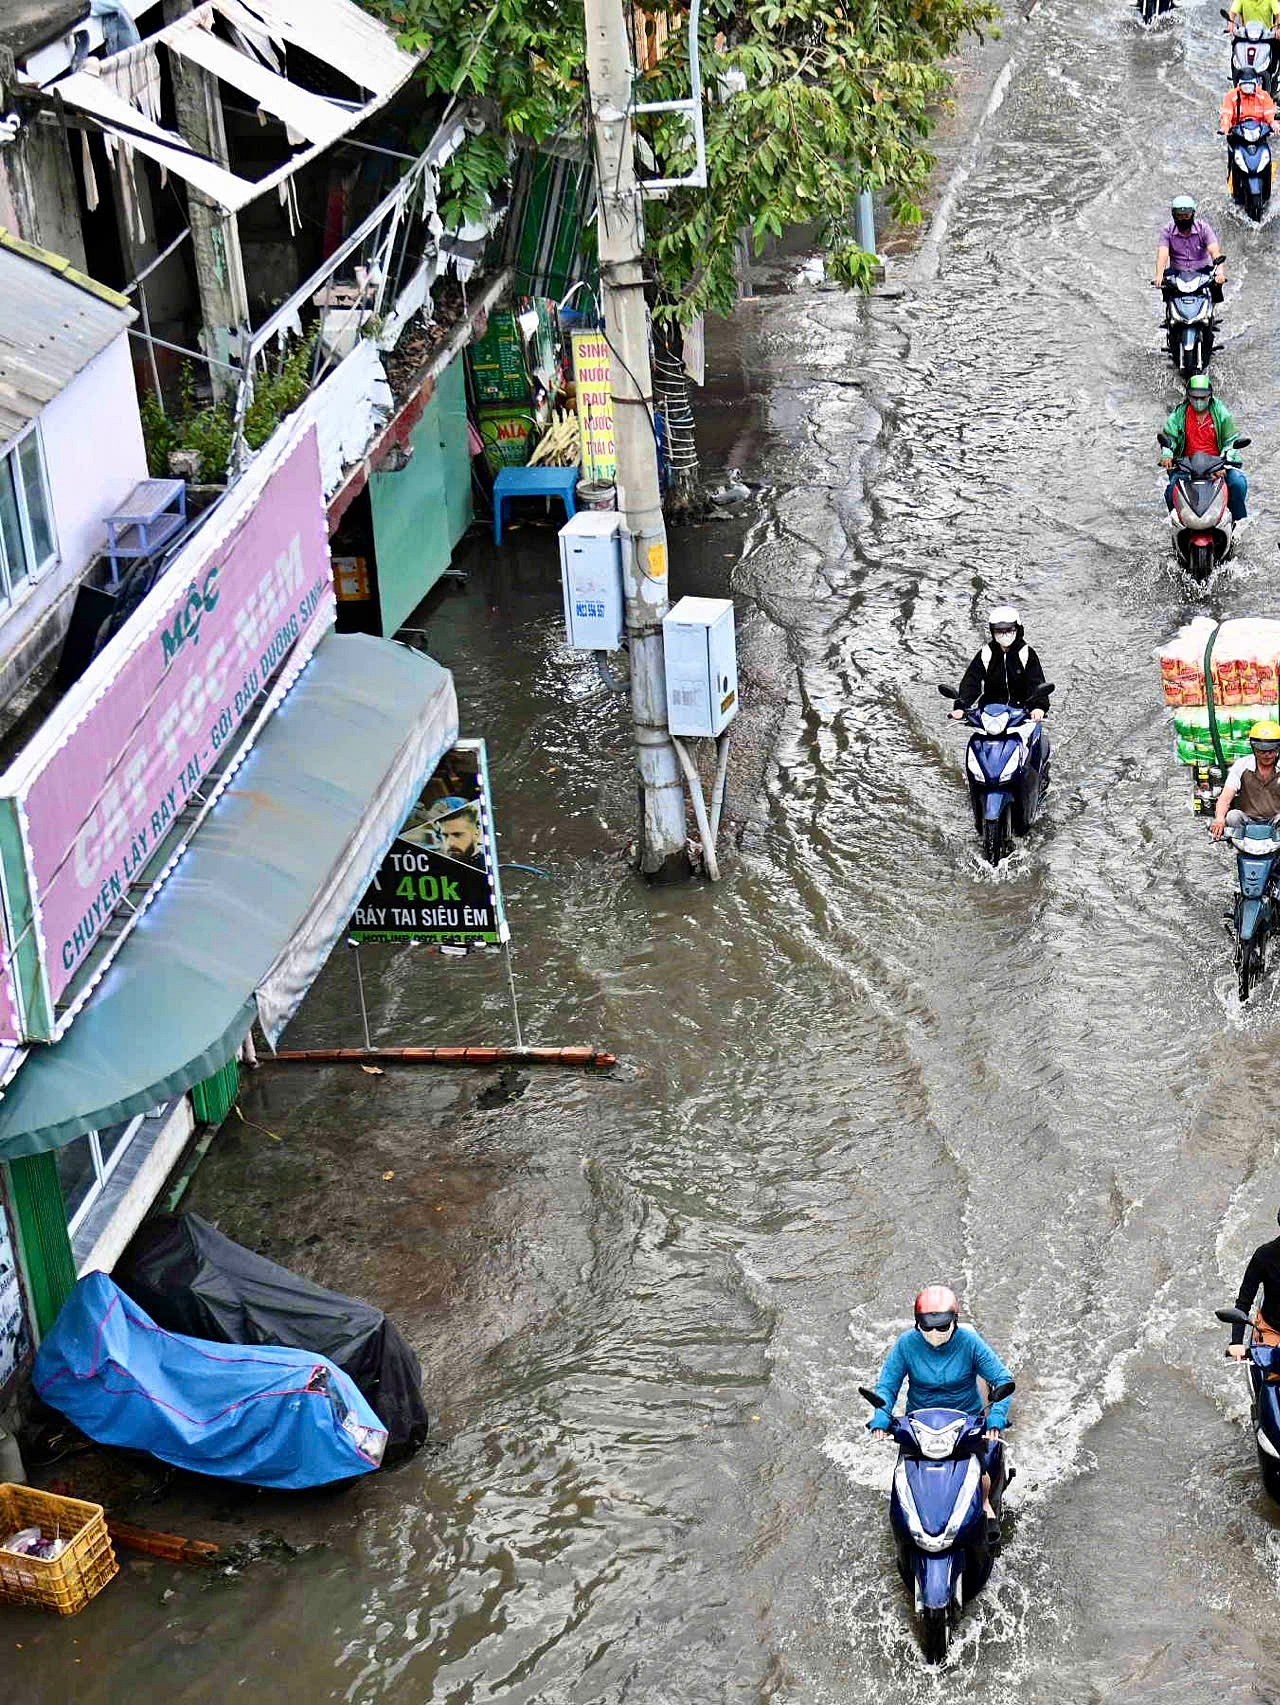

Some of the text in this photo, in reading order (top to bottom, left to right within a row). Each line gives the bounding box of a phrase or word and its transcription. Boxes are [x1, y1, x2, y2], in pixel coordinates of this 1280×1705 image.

[583, 392, 607, 406] RAU
[234, 532, 304, 668] NAM
[160, 567, 220, 667] MỘC
[178, 754, 201, 795] TAI
[390, 850, 430, 872] TÓC
[396, 875, 462, 901] 40k
[355, 905, 489, 927] RÁY TAI SIÊU ÊM
